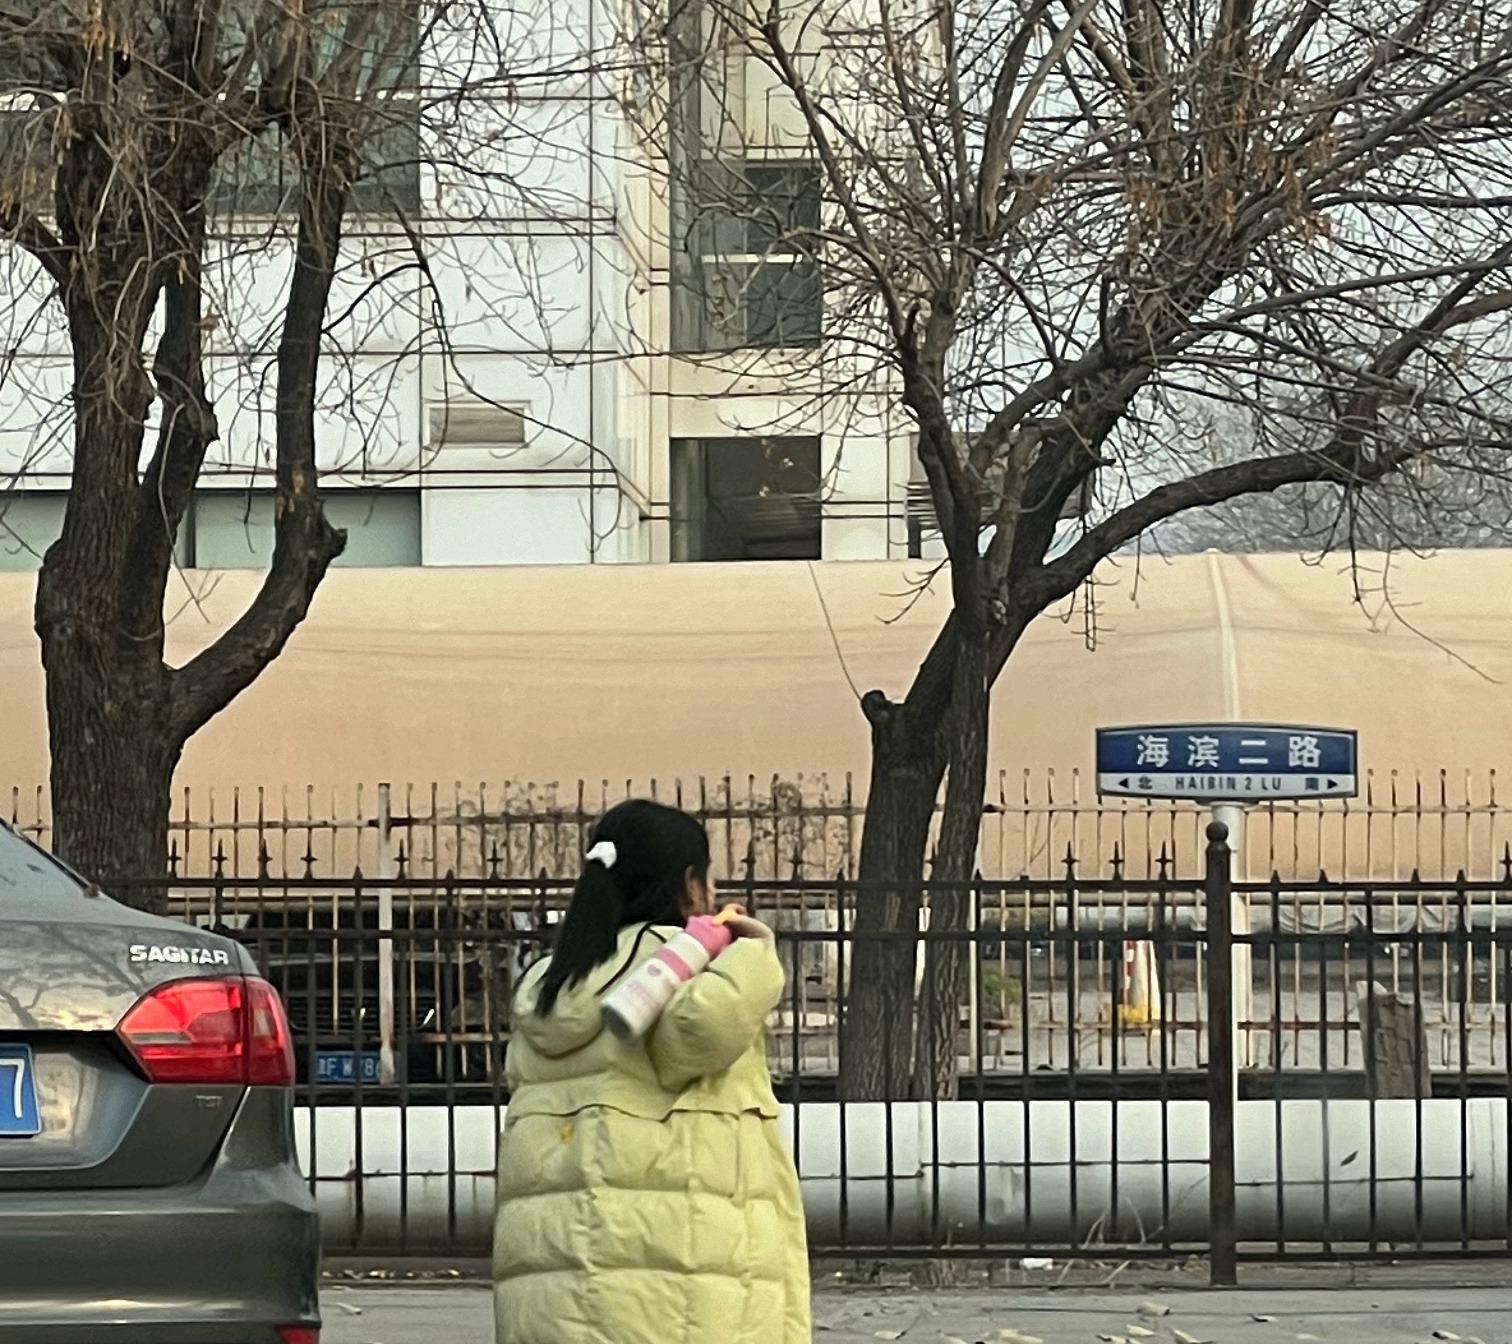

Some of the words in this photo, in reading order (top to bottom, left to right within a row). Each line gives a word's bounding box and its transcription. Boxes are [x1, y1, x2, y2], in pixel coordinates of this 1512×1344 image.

[1136, 735, 1322, 768] 海滨二路
[1175, 776, 1236, 791] HAIBIN
[1244, 776, 1253, 791] 2
[1261, 776, 1282, 791] LU
[128, 944, 230, 965] SAGITAR
